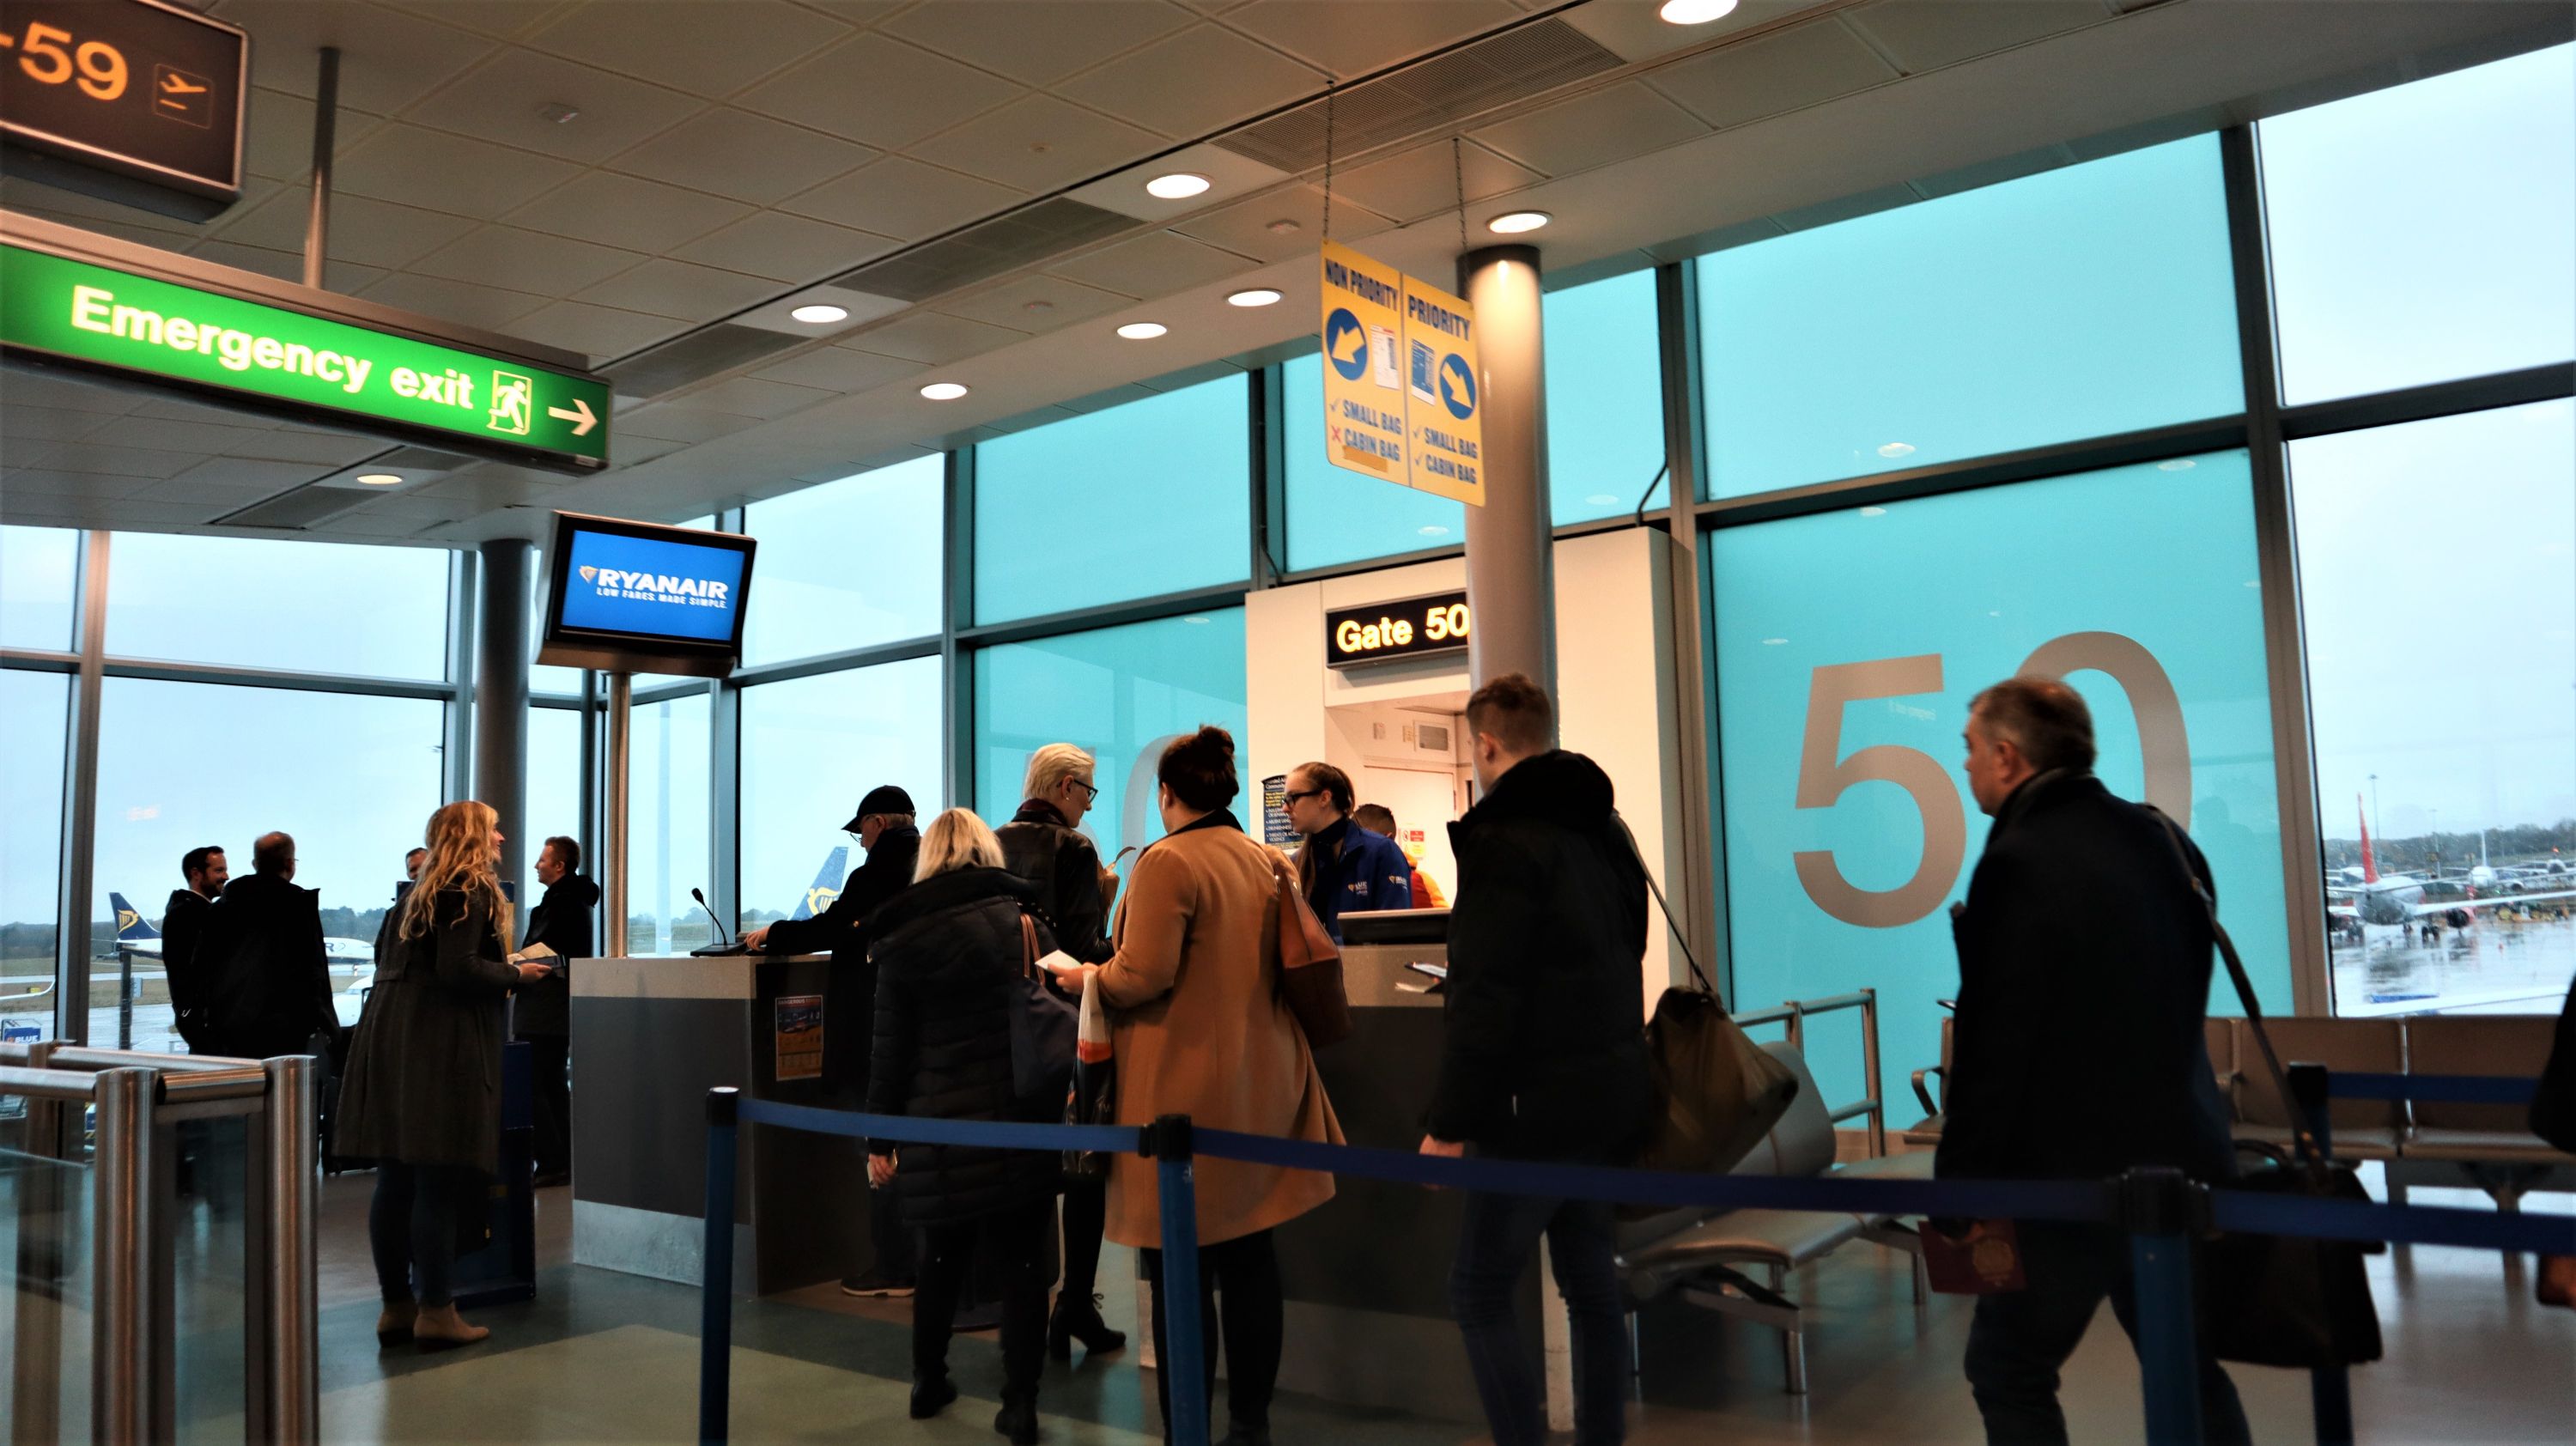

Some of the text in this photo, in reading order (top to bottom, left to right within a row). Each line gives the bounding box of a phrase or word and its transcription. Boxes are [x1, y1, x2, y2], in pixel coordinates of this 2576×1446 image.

[1325, 257, 1399, 313] NON PRIORITY
[1407, 294, 1471, 342] PRIORITY
[71, 284, 474, 410] Emergency exit
[1343, 399, 1401, 435] SMALL BAG
[1345, 428, 1400, 462] CABIN BAG
[1424, 427, 1478, 459] SMALL BAG
[1425, 454, 1477, 484] CABIN BAG
[596, 587, 619, 598] LOW
[658, 593, 687, 605] MADE
[598, 568, 728, 600] RYANAIR
[1336, 603, 1471, 653] Gate 50
[15, 1035, 39, 1043] BLUE
